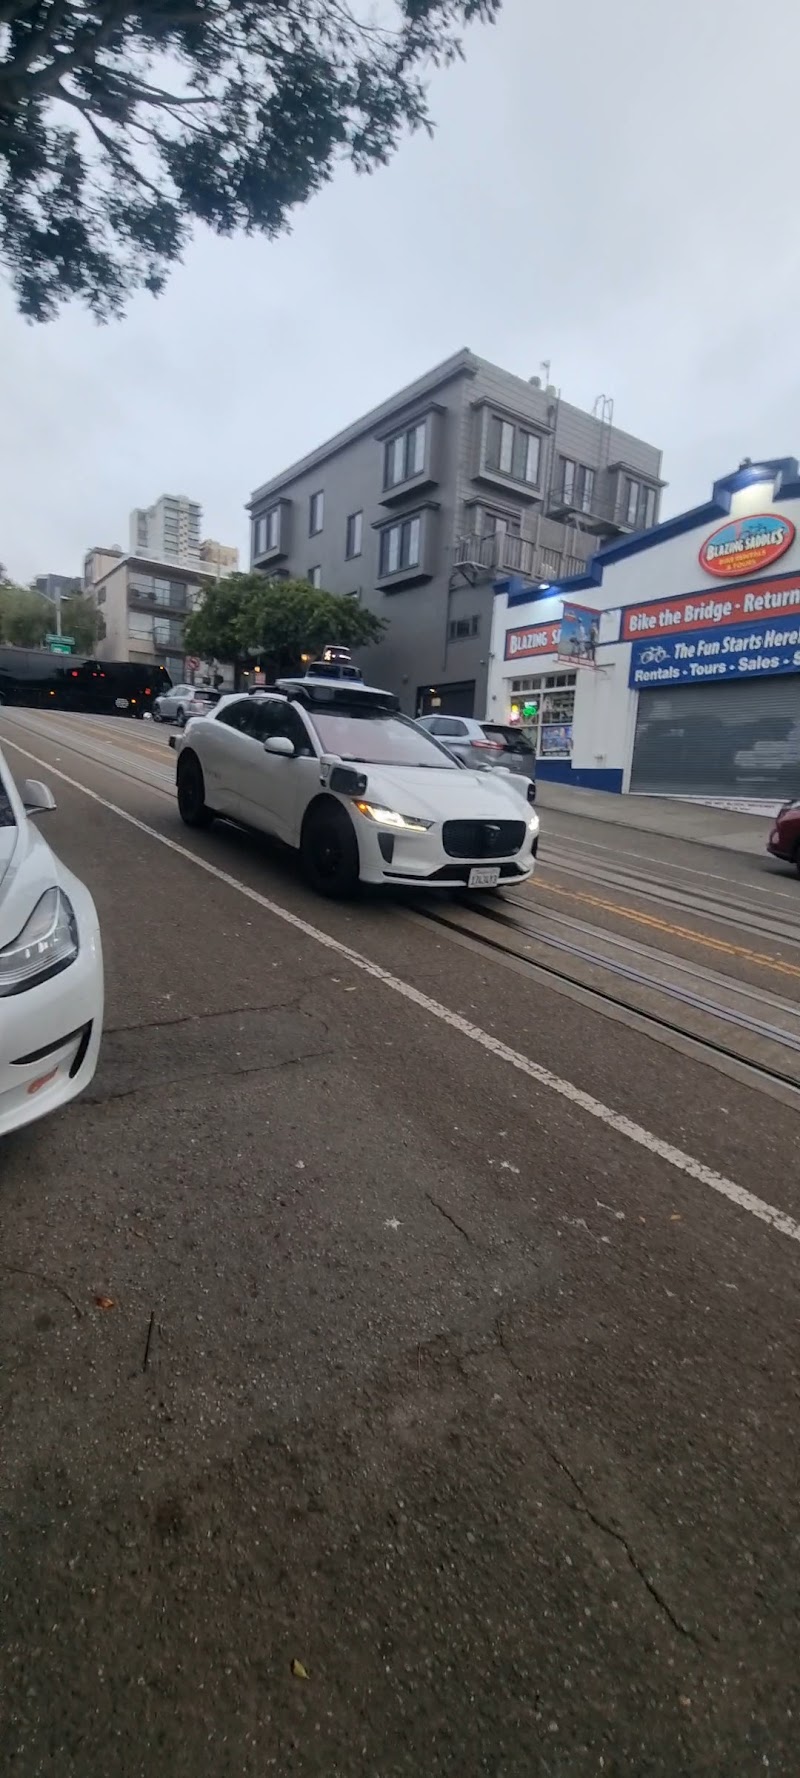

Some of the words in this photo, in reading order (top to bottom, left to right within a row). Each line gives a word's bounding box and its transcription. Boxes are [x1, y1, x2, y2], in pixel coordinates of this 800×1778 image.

[629, 613, 656, 632] Bike
[658, 609, 681, 627] the
[684, 600, 732, 622] Bridge
[743, 588, 800, 612] Return
[510, 632, 548, 654] BLAZING
[674, 643, 695, 659] The
[697, 639, 720, 656] Fun
[721, 634, 762, 653] Starts
[635, 666, 680, 682] Rentals
[689, 662, 727, 676] Tours
[738, 656, 780, 671] Sales
